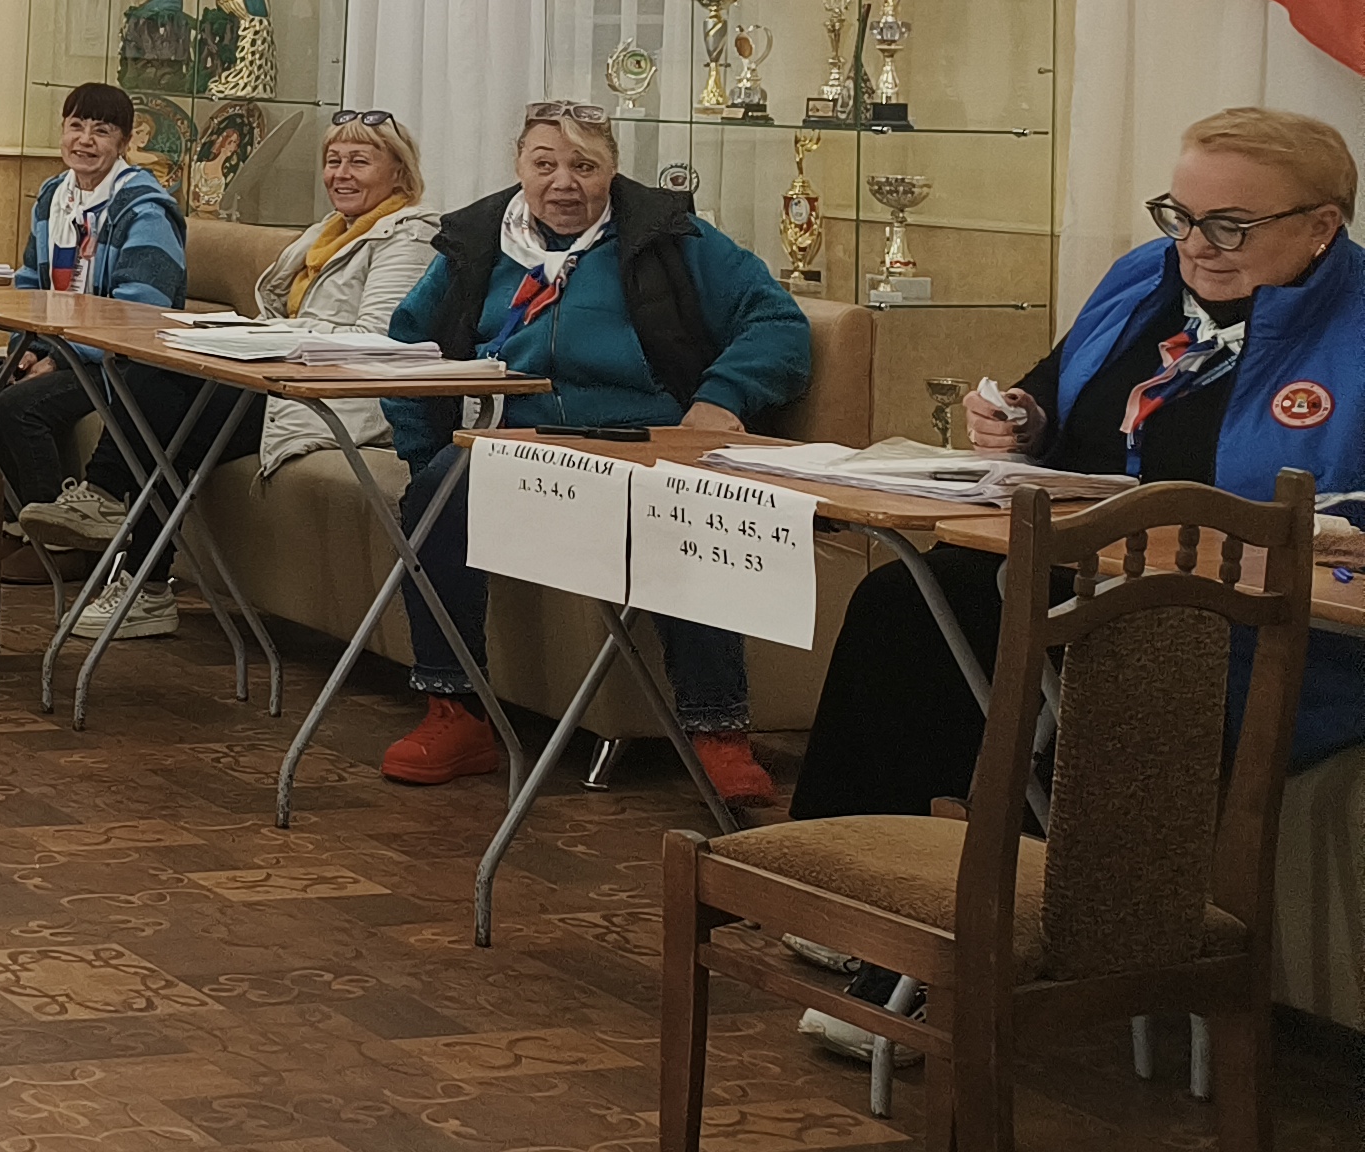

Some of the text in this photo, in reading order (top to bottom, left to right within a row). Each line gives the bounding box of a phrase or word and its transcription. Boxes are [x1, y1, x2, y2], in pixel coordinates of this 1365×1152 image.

[488, 442, 616, 476] ул. ШКОЛЬНАЯ
[519, 477, 576, 501] д. 3, 4, 6
[666, 476, 777, 508] пр. ИЛЬИЧА
[647, 504, 796, 549] д. 41, 43, 45, 47,
[679, 540, 764, 573] 49, 51, 53
